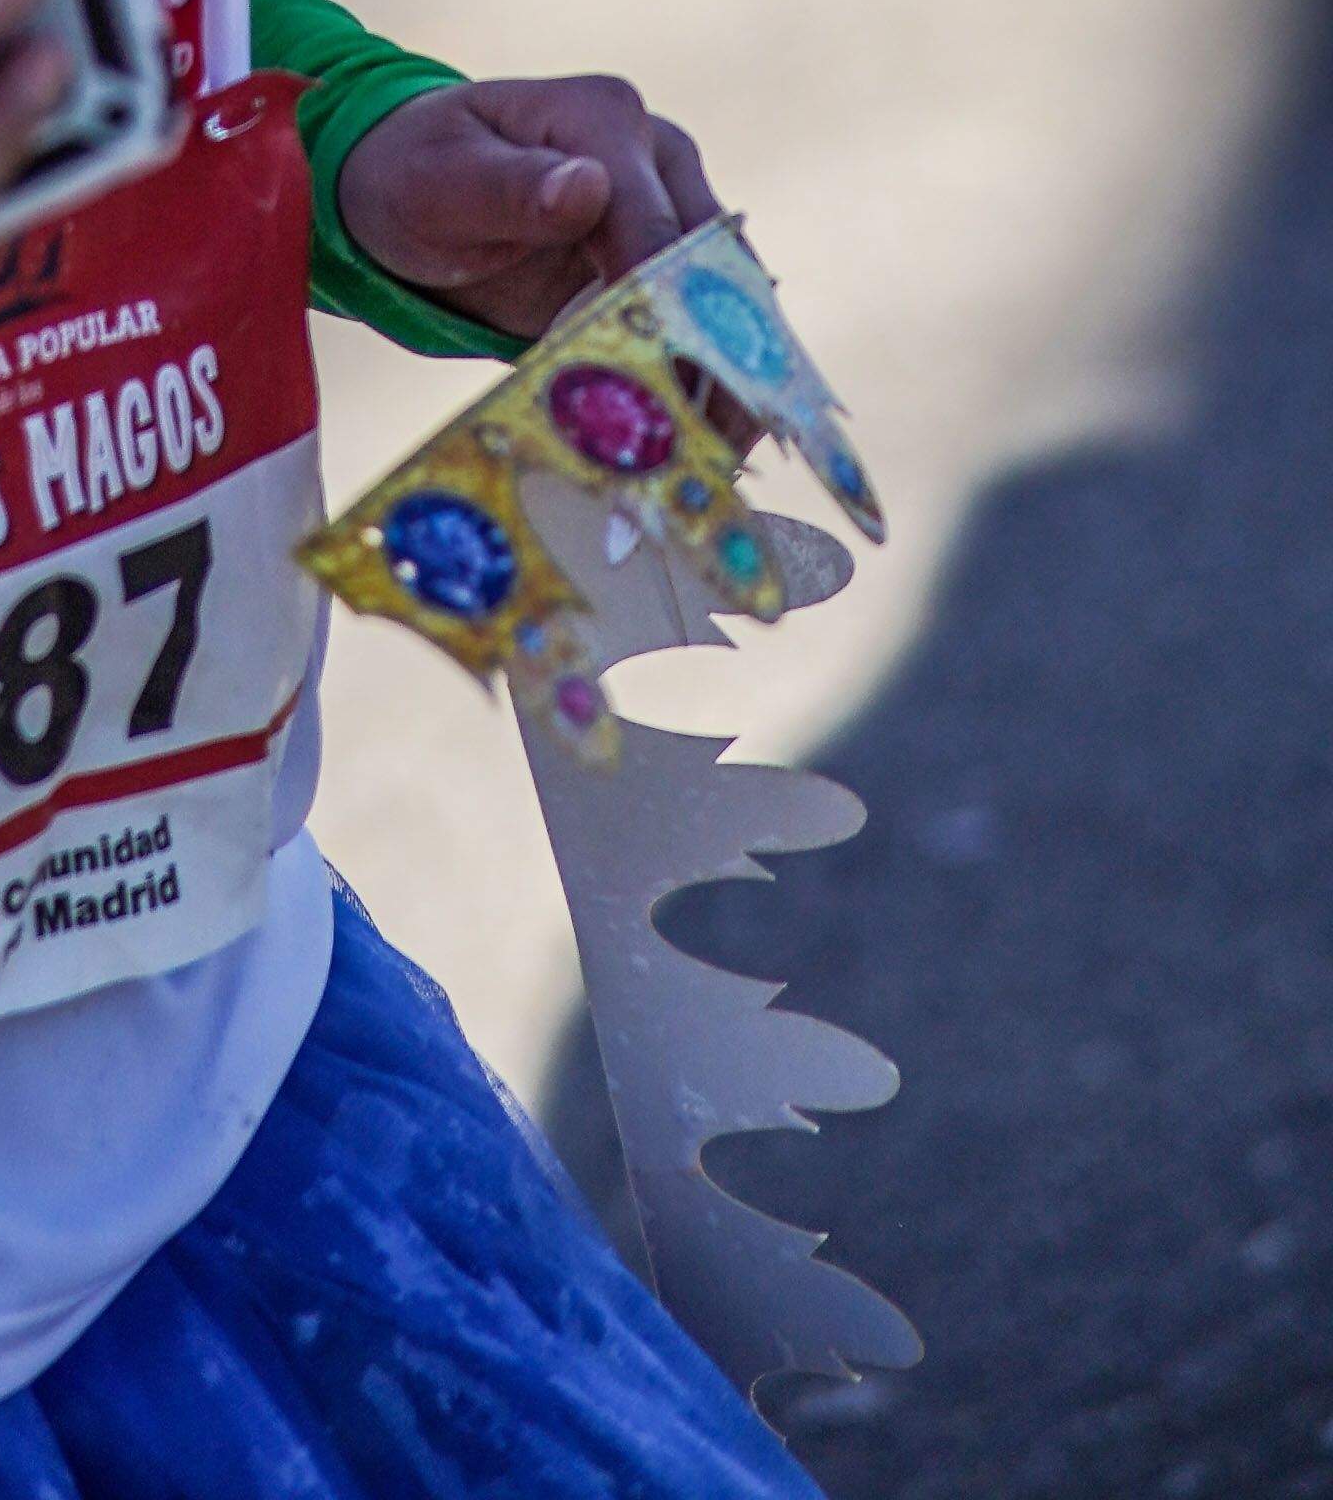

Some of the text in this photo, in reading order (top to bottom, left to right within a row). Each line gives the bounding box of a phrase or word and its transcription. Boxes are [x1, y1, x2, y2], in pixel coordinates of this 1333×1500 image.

[16, 300, 161, 371] POPULAR
[23, 344, 225, 531] MAGOS
[2, 813, 172, 919] Cunidad
[34, 863, 180, 939] Madrid
